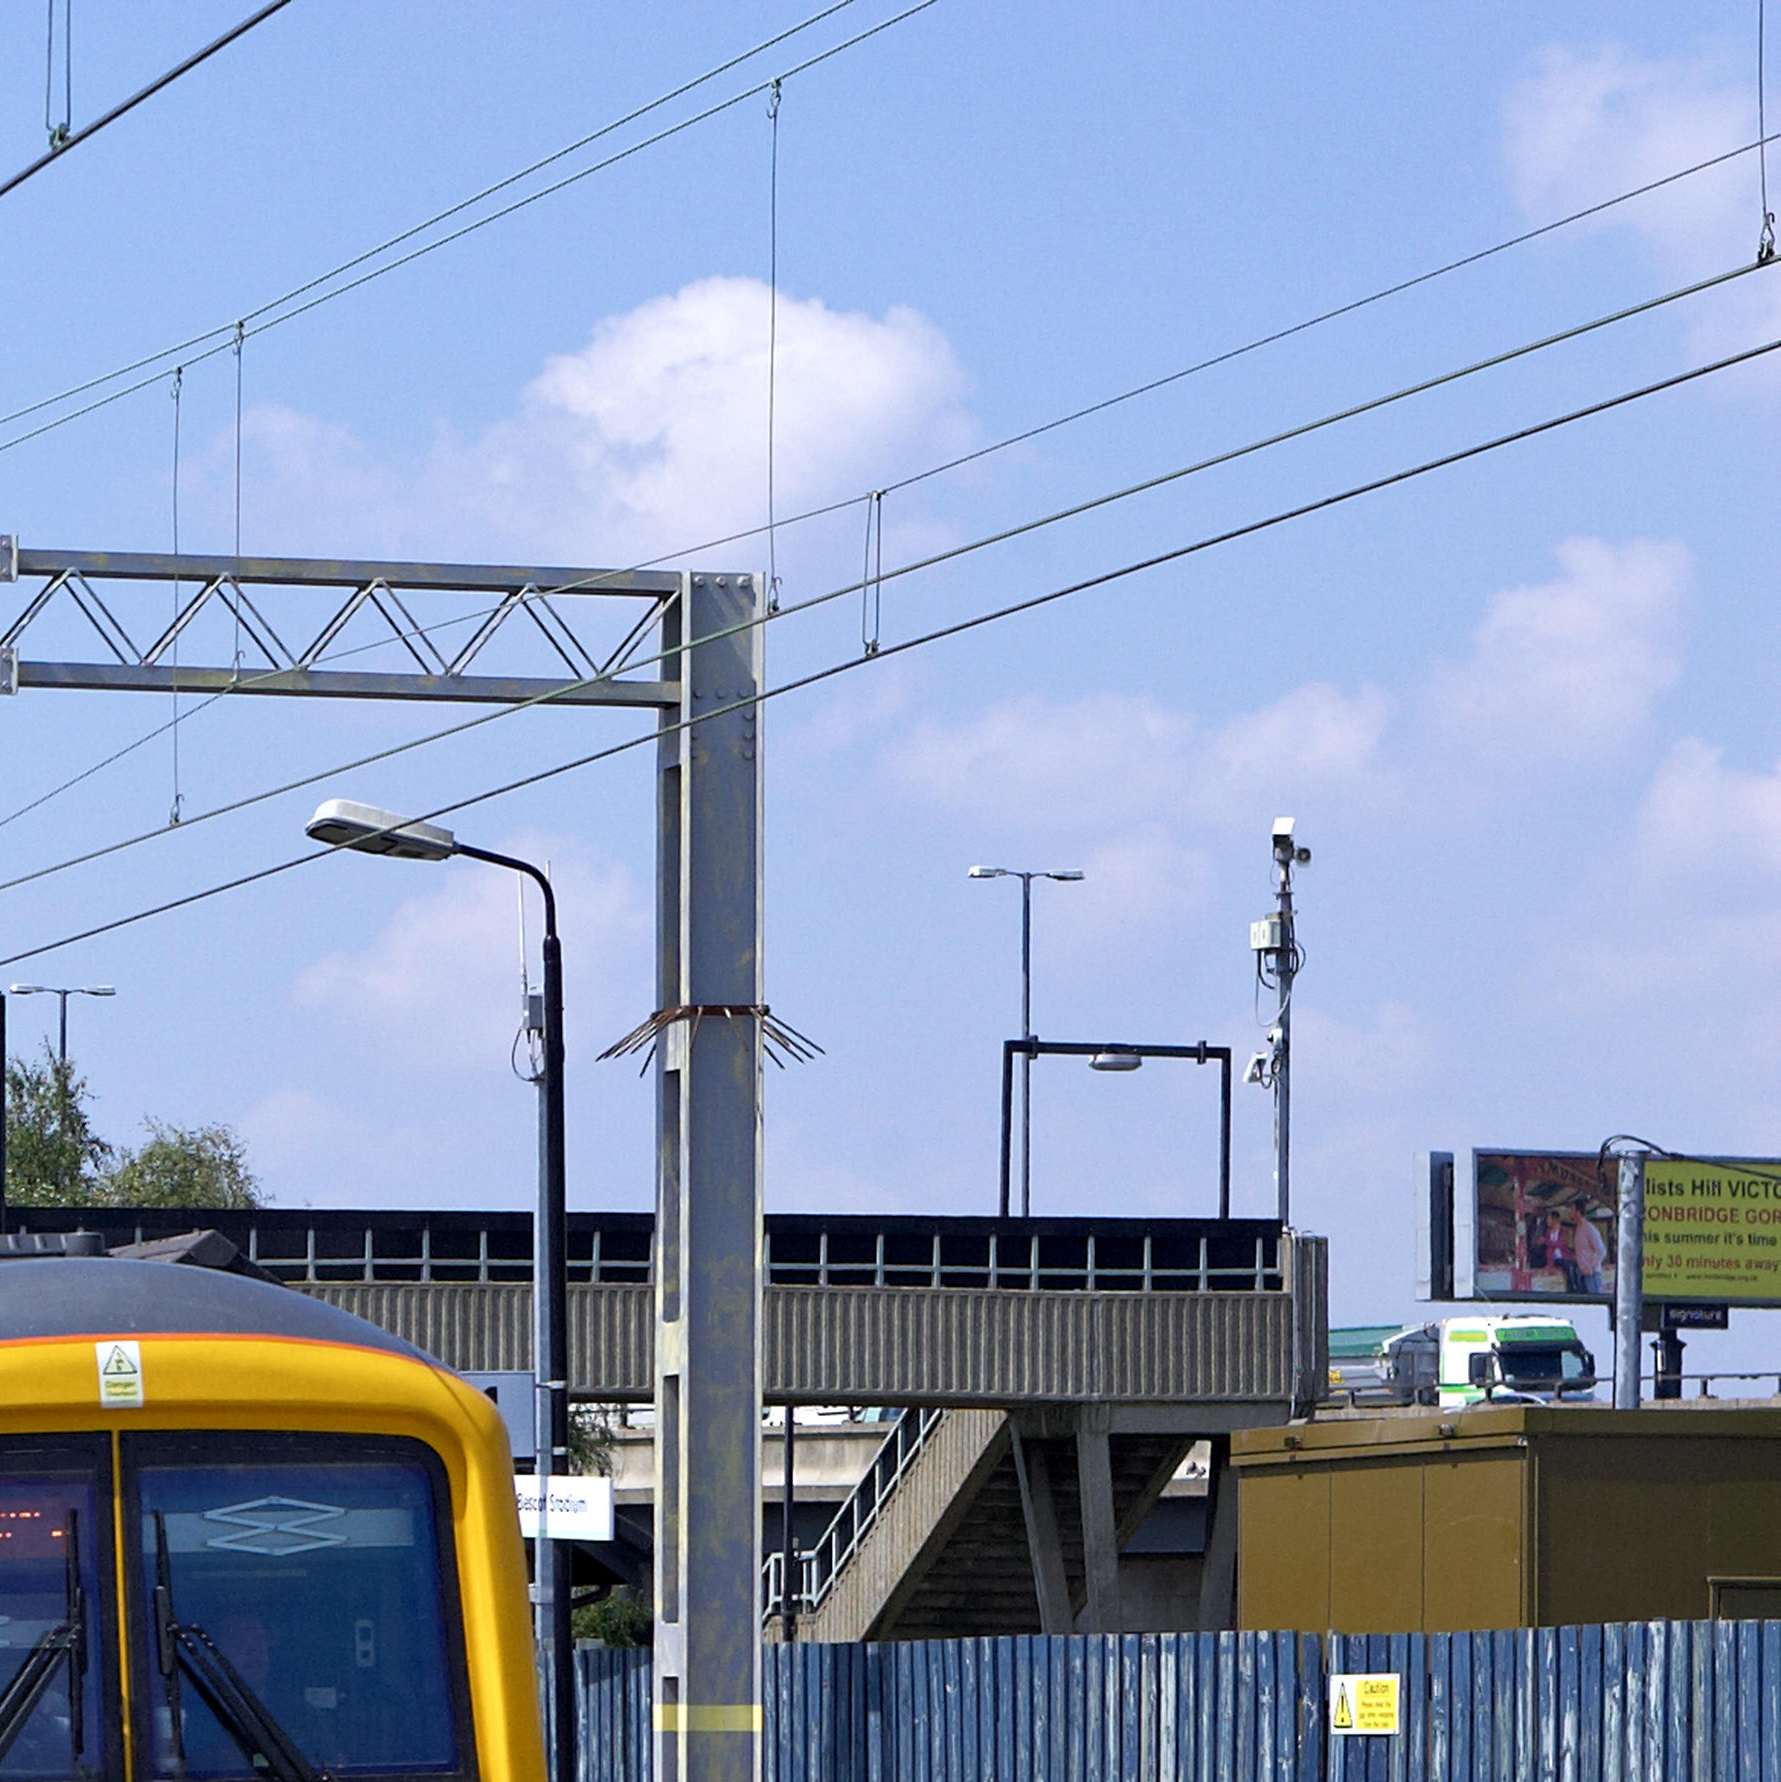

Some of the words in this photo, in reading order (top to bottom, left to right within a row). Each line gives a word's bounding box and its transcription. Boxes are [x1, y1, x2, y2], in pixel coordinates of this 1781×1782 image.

[1646, 1177, 1685, 1197] lists
[1691, 1179, 1722, 1197] Hill
[1643, 1206, 1740, 1223] ONBRIDGE
[1664, 1232, 1720, 1245] summer
[1724, 1232, 1744, 1246] it's
[1747, 1233, 1777, 1247] time
[1643, 1254, 1663, 1270] nly
[1667, 1254, 1683, 1268] 30
[1686, 1255, 1741, 1270] minutes
[1745, 1258, 1779, 1273] away
